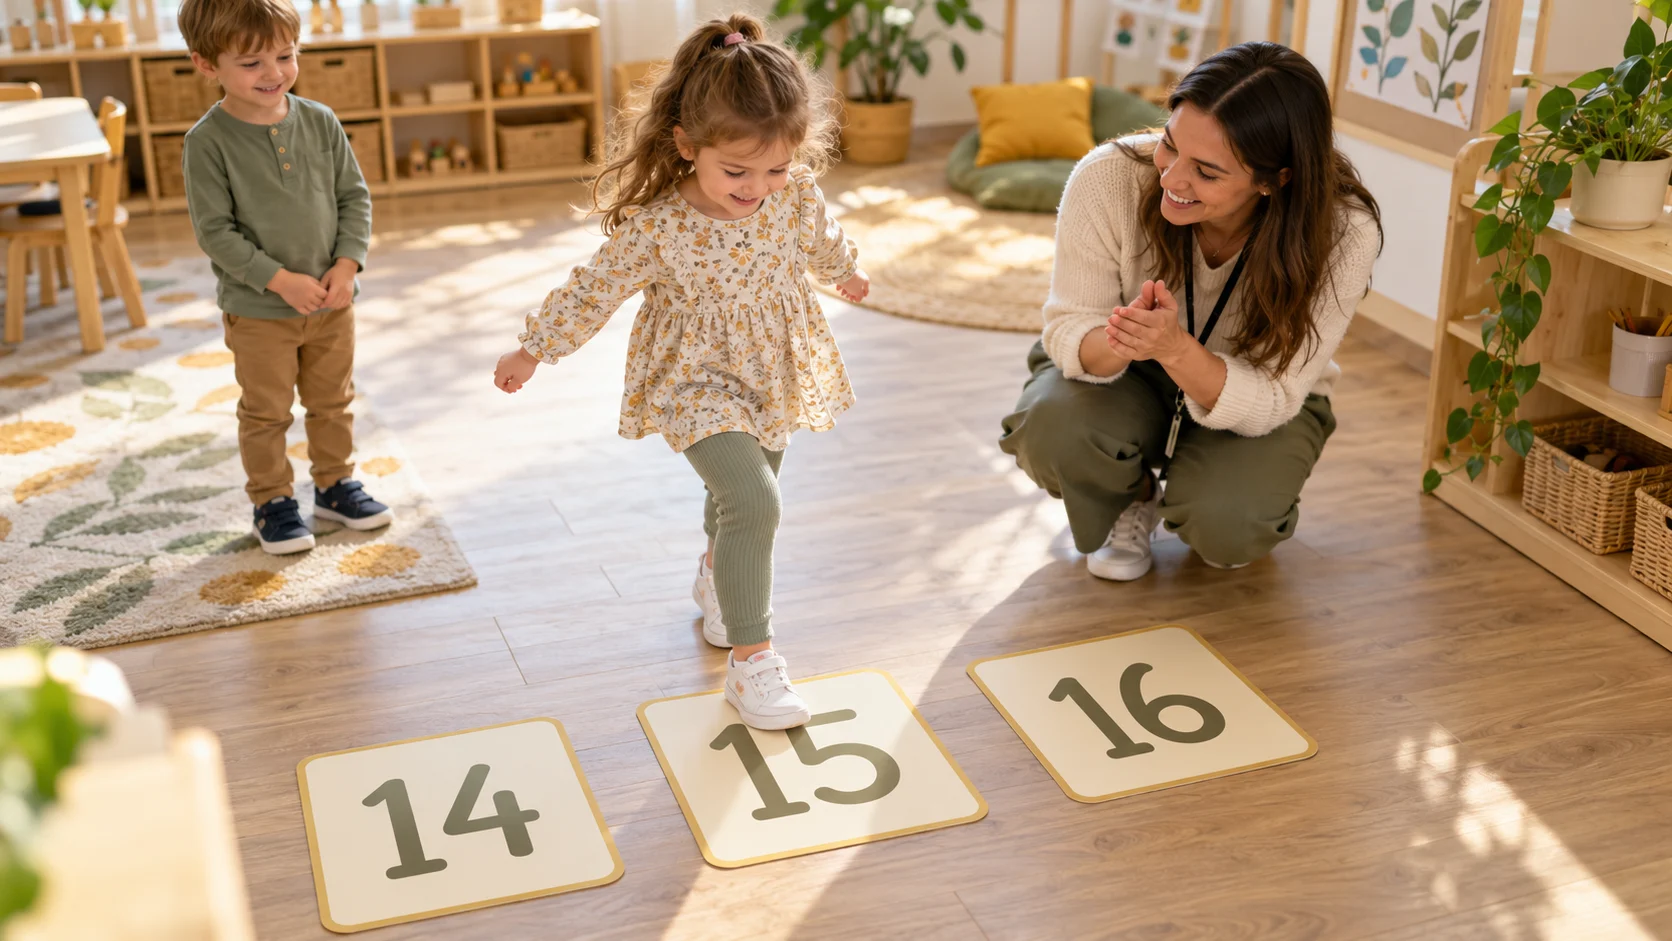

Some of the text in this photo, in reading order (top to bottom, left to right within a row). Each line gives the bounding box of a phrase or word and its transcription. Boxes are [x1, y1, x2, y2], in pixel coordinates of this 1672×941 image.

[709, 708, 901, 820] 15
[1048, 662, 1226, 759] 16
[361, 764, 540, 880] 14
